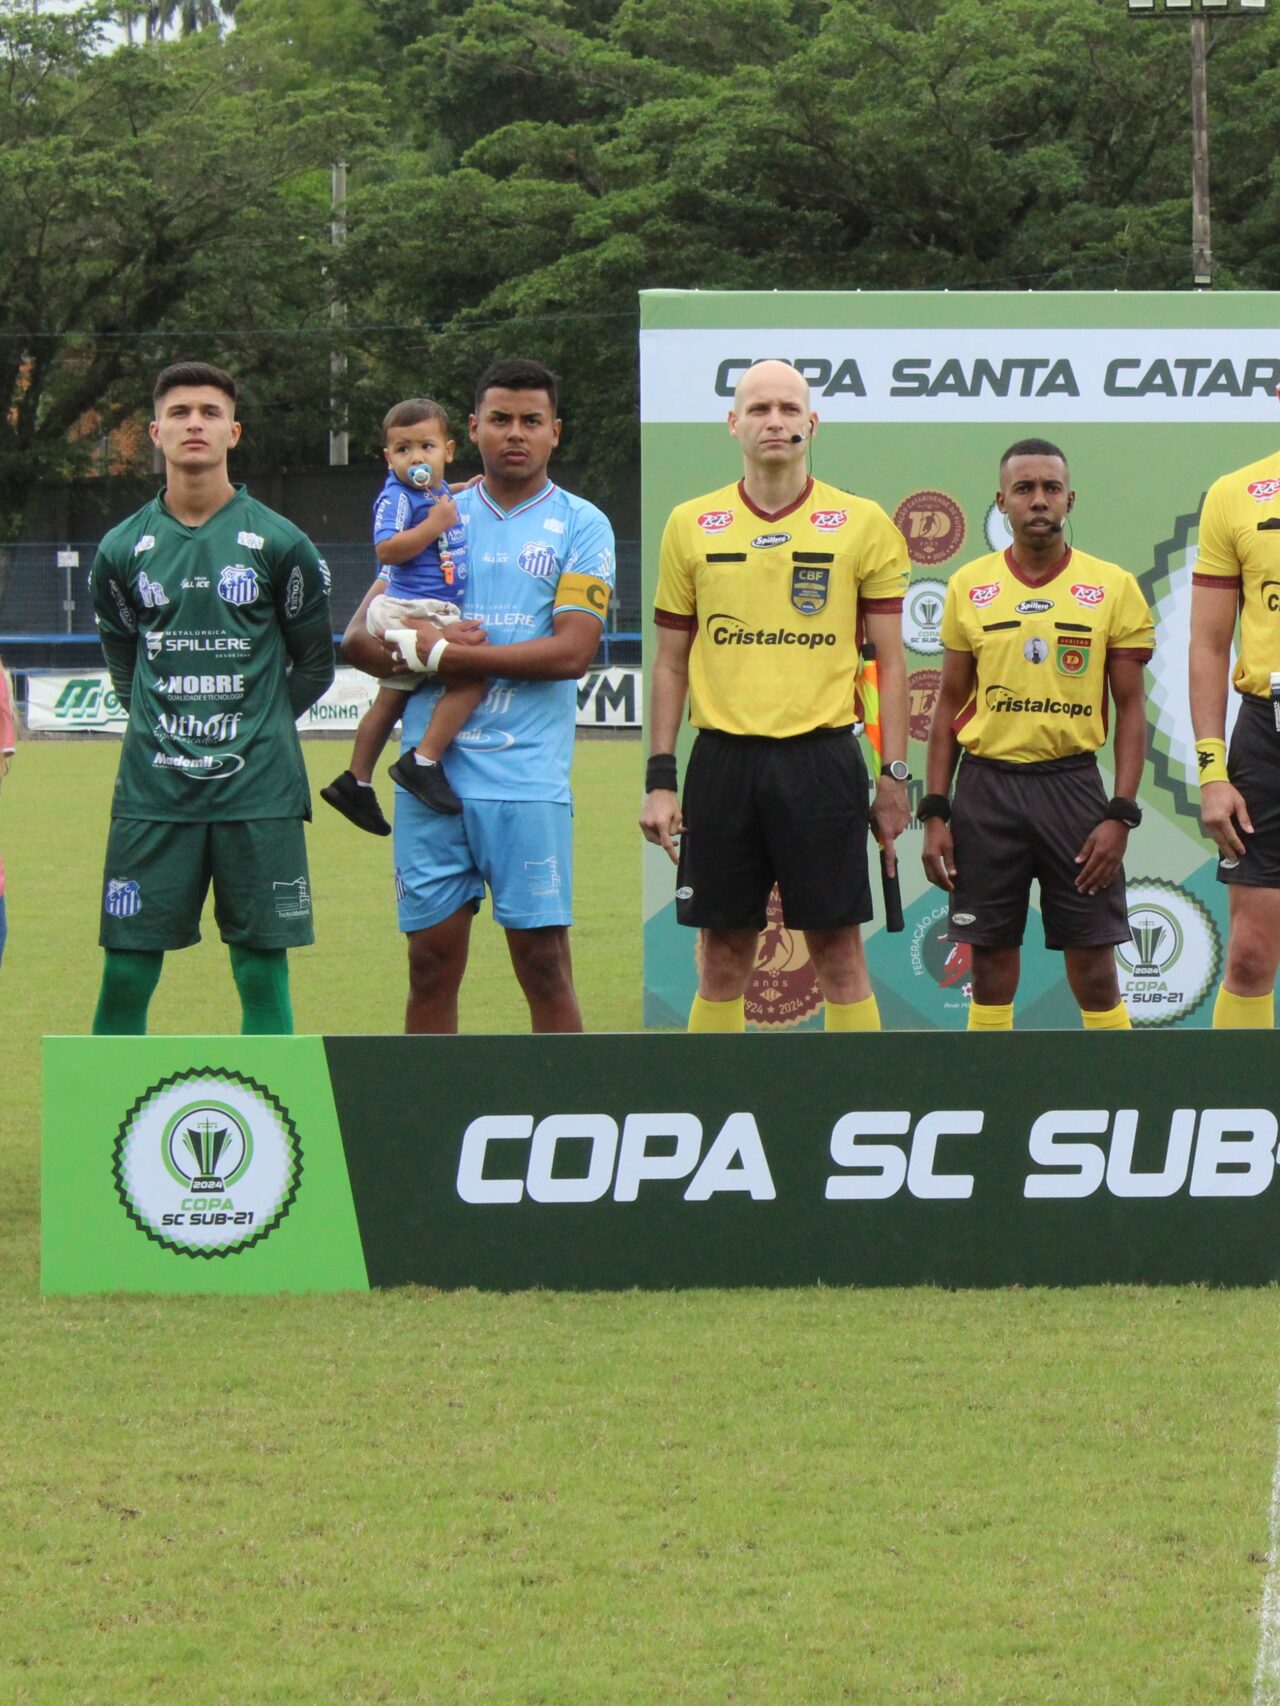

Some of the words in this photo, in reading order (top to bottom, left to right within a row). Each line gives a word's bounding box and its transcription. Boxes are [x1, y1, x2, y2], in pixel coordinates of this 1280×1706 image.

[714, 358, 867, 397] CPA
[889, 358, 1080, 397] SANTA
[798, 570, 824, 581] CBF
[586, 584, 605, 610] C
[165, 637, 252, 652] SPILLERE
[713, 626, 836, 650] Cristalcopo
[167, 674, 244, 694] NOBRE
[167, 693, 201, 702] QUALIDADE
[155, 712, 244, 742] Althoff
[153, 752, 214, 769] Mademil
[910, 916, 932, 977] FEDERAÇÃO
[753, 980, 789, 988] anos
[1125, 981, 1168, 992] COPA
[1131, 992, 1184, 1003] SUB-21
[745, 999, 763, 1015] 924
[779, 999, 804, 1015] 2024
[456, 1112, 777, 1204] COPA
[824, 1110, 985, 1200] SC
[192, 1181, 223, 1190] 2024
[180, 1198, 235, 1211] COPA
[161, 1213, 186, 1226] SC
[189, 1211, 255, 1226] SUB-21
